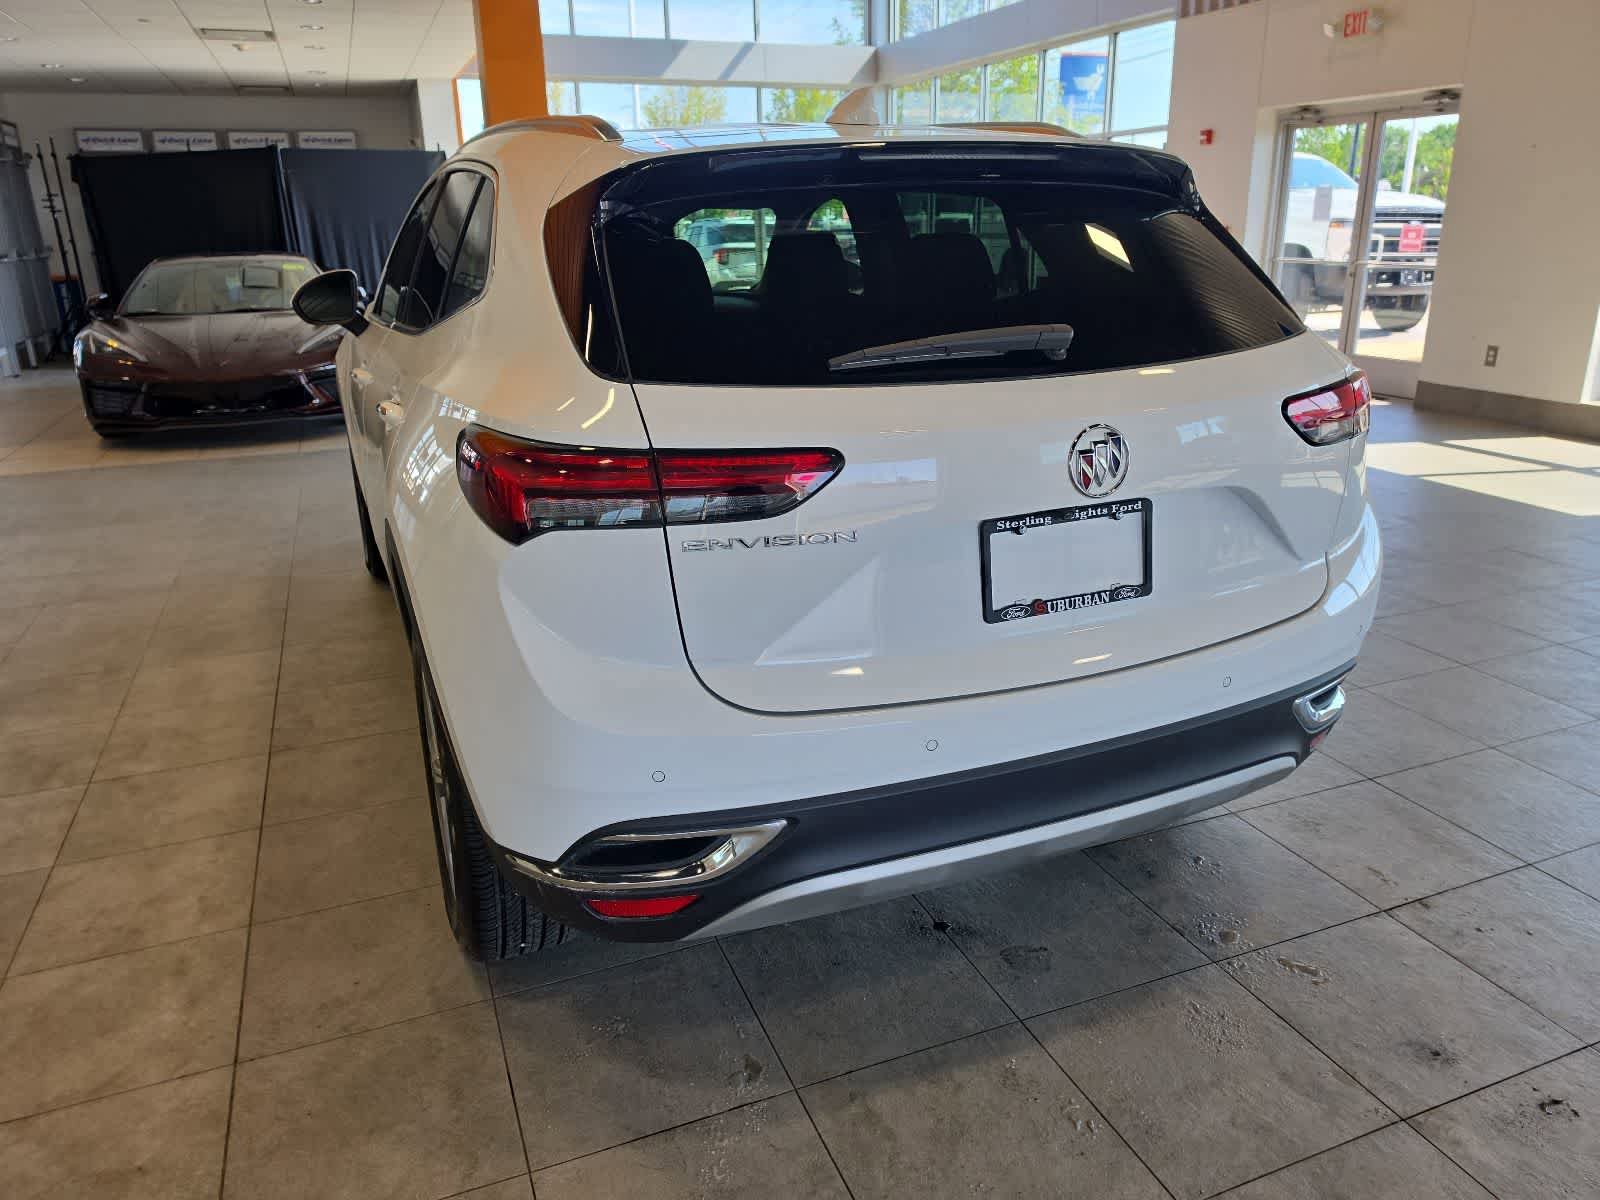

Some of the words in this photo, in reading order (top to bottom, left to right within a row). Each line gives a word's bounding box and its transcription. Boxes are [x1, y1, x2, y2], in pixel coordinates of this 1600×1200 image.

[1344, 9, 1370, 38] EXIT
[996, 514, 1052, 530] Sterling
[1062, 507, 1108, 521] ights
[1111, 501, 1143, 514] Ford
[681, 529, 858, 553] ENVISION
[1032, 591, 1110, 615] SUBURBAN
